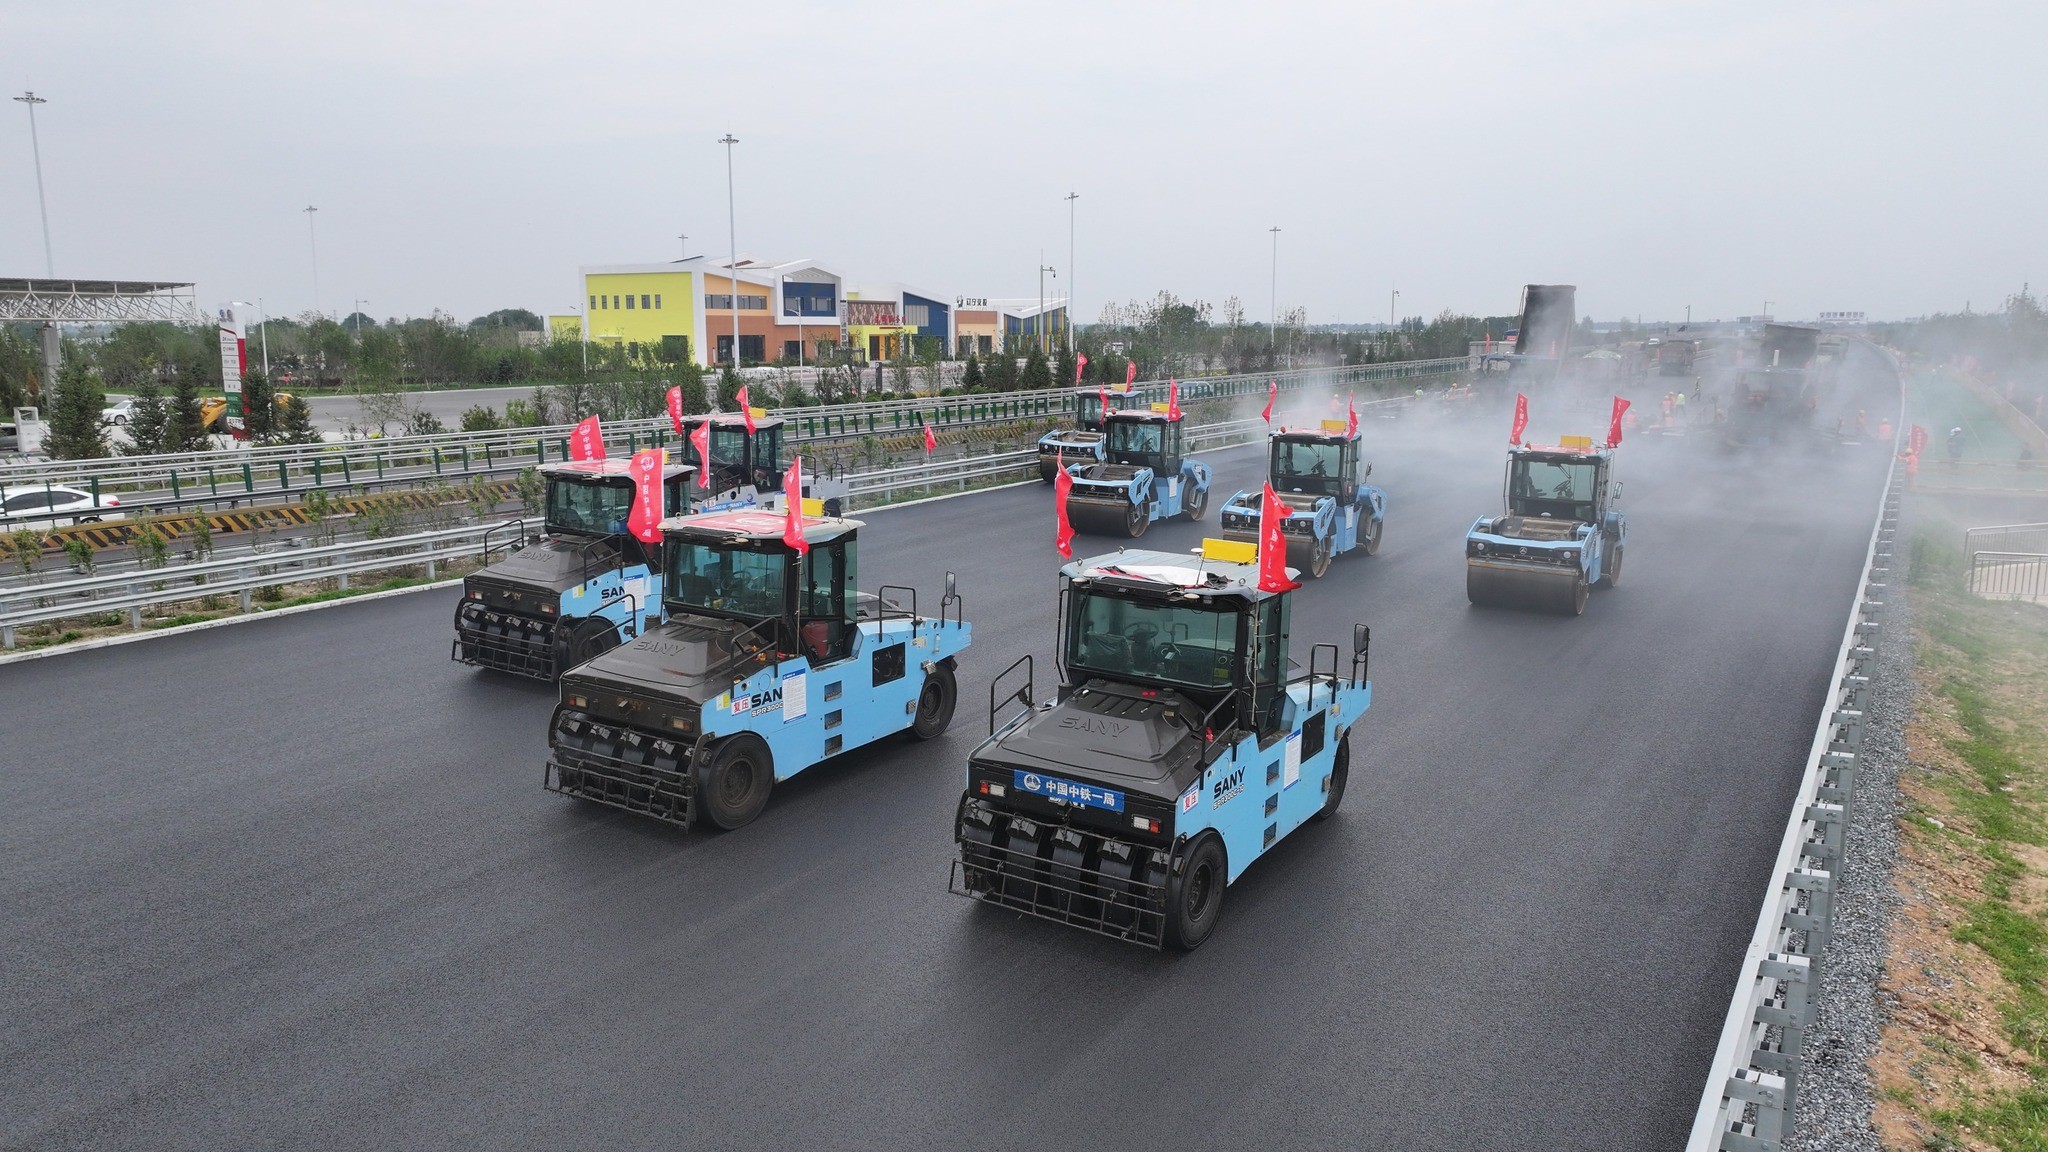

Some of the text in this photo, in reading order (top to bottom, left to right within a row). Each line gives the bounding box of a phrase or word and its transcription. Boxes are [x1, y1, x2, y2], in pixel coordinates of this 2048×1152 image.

[601, 586, 625, 599] SAN
[634, 641, 686, 656] SANY
[751, 687, 783, 708] SAN
[1058, 717, 1130, 738] SANY
[1214, 766, 1246, 799] SANY
[1046, 780, 1115, 807] 中国中铁一局
